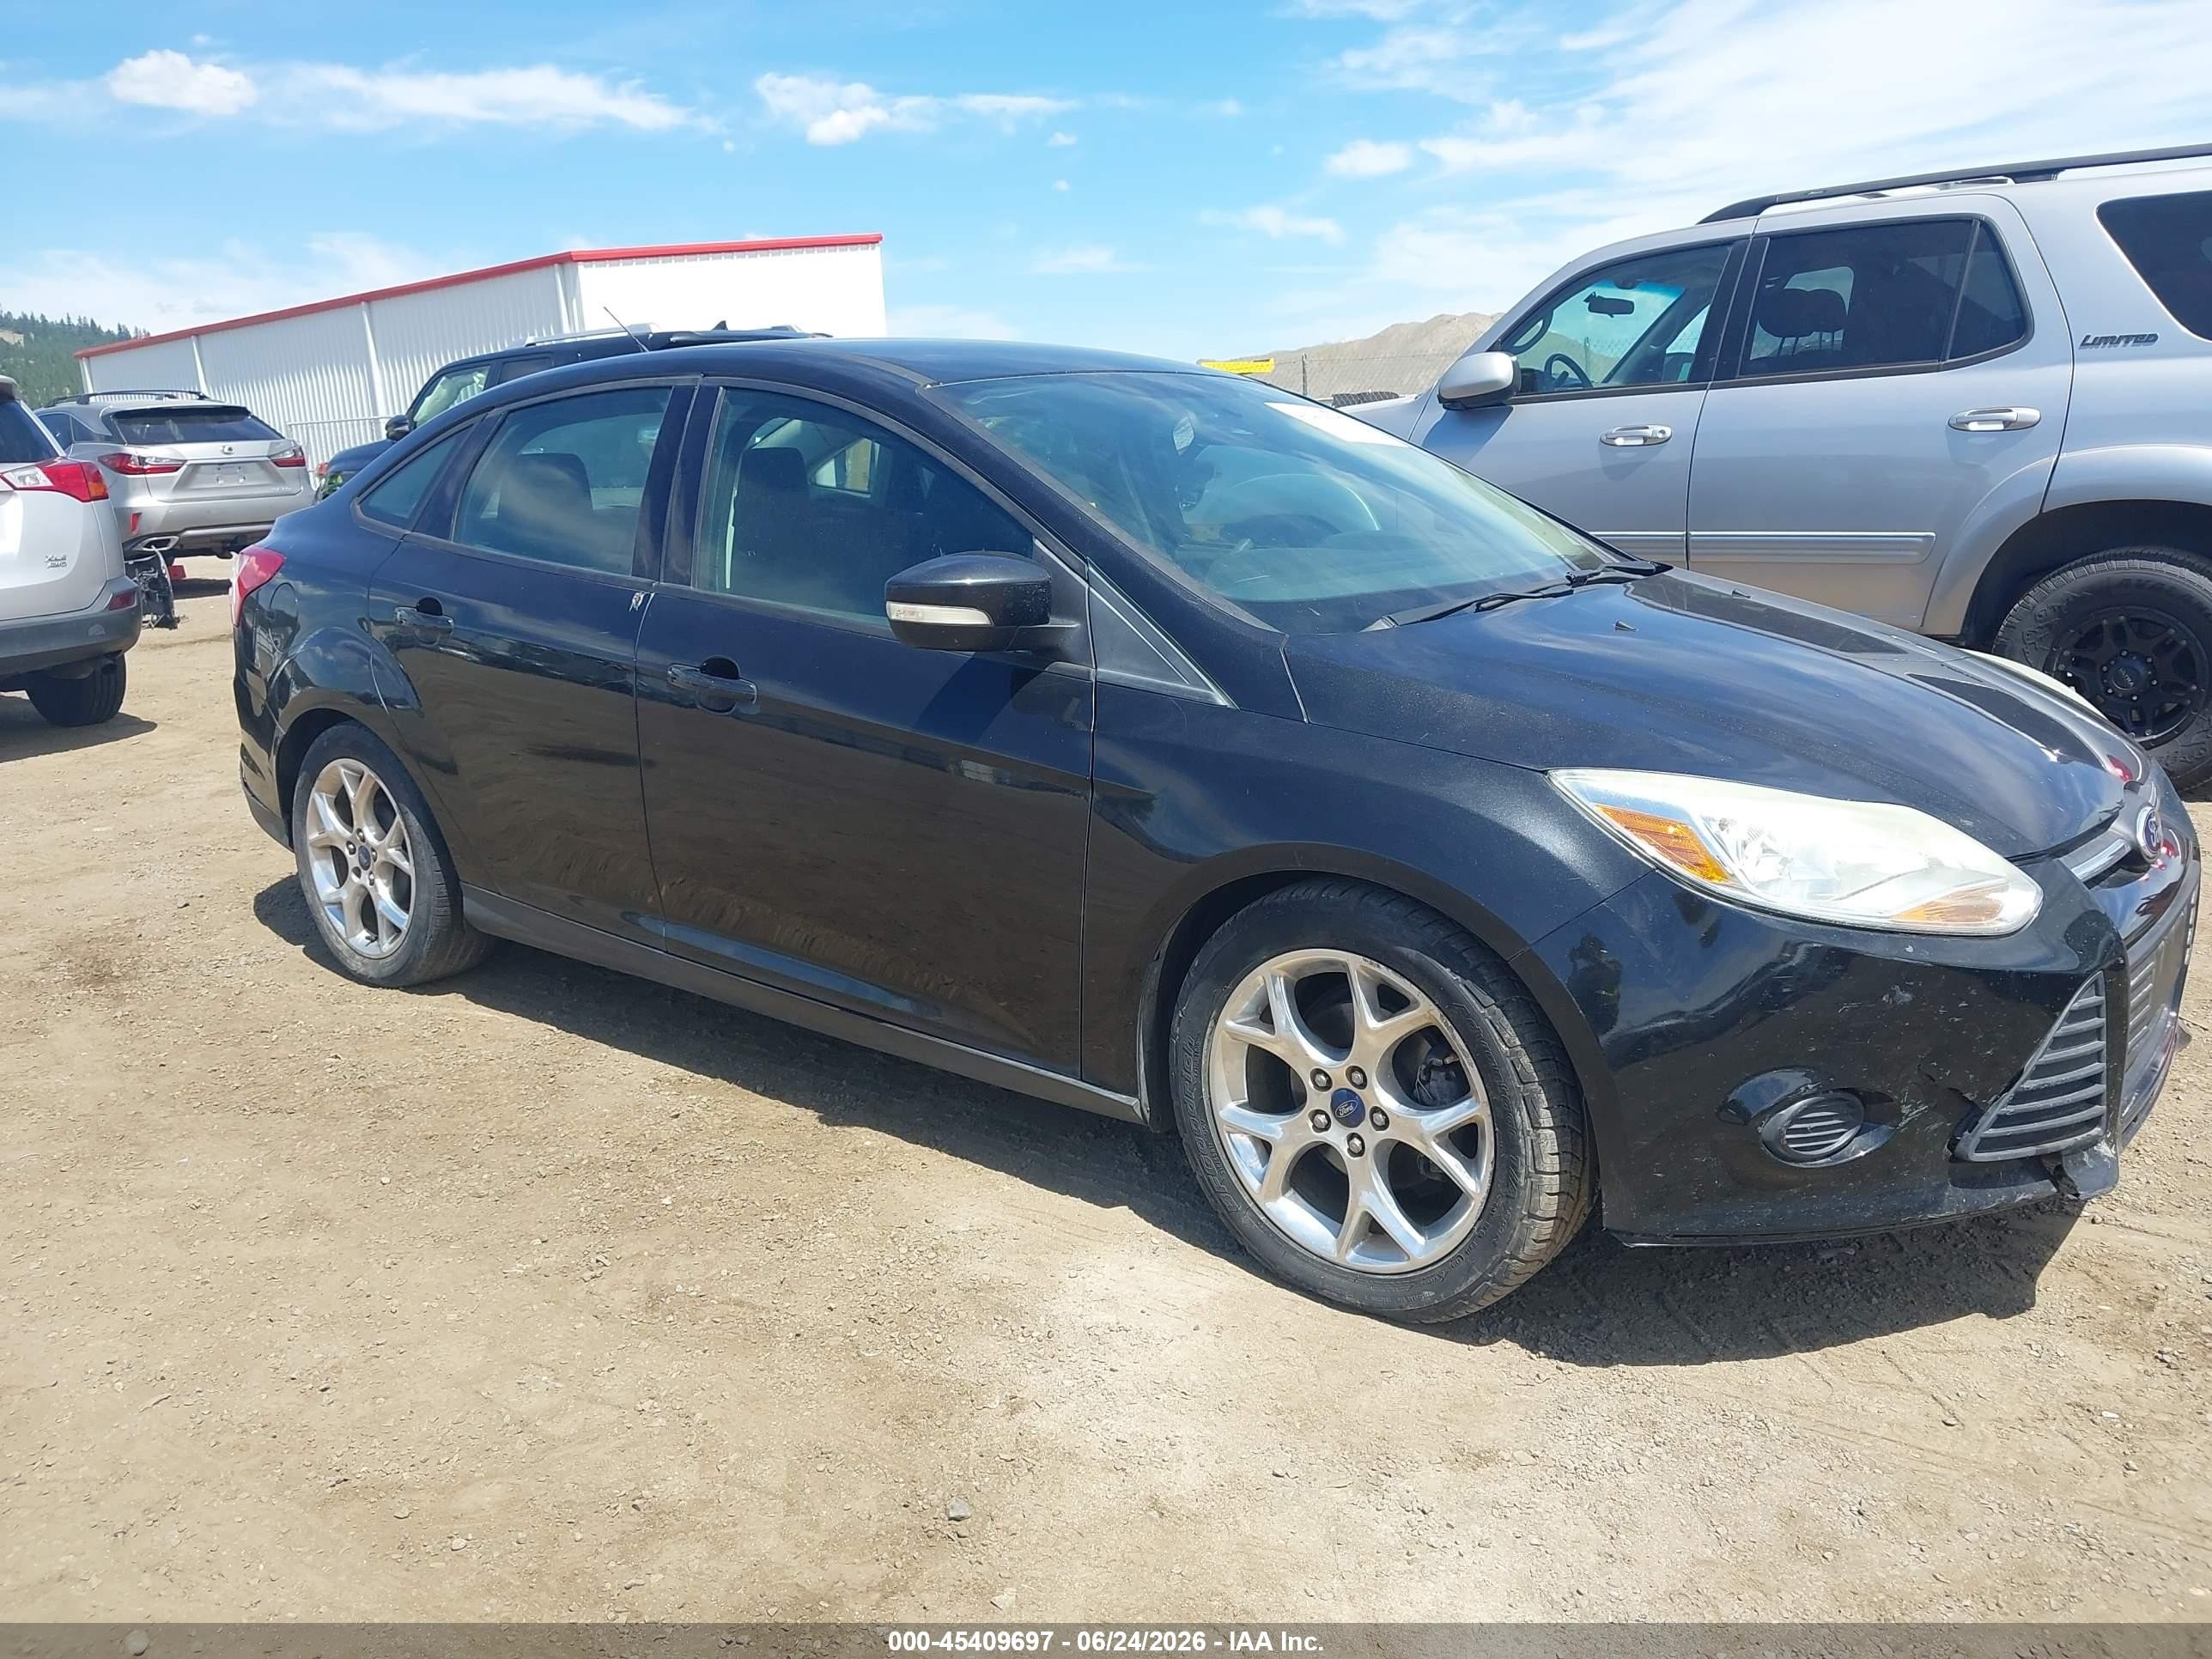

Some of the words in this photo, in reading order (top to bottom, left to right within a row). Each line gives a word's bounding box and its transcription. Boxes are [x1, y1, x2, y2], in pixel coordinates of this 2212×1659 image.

[2079, 333, 2159, 349] LIMITED
[1339, 1103, 1354, 1116] Ford
[1181, 1034, 1238, 1212] BFGoodrich
